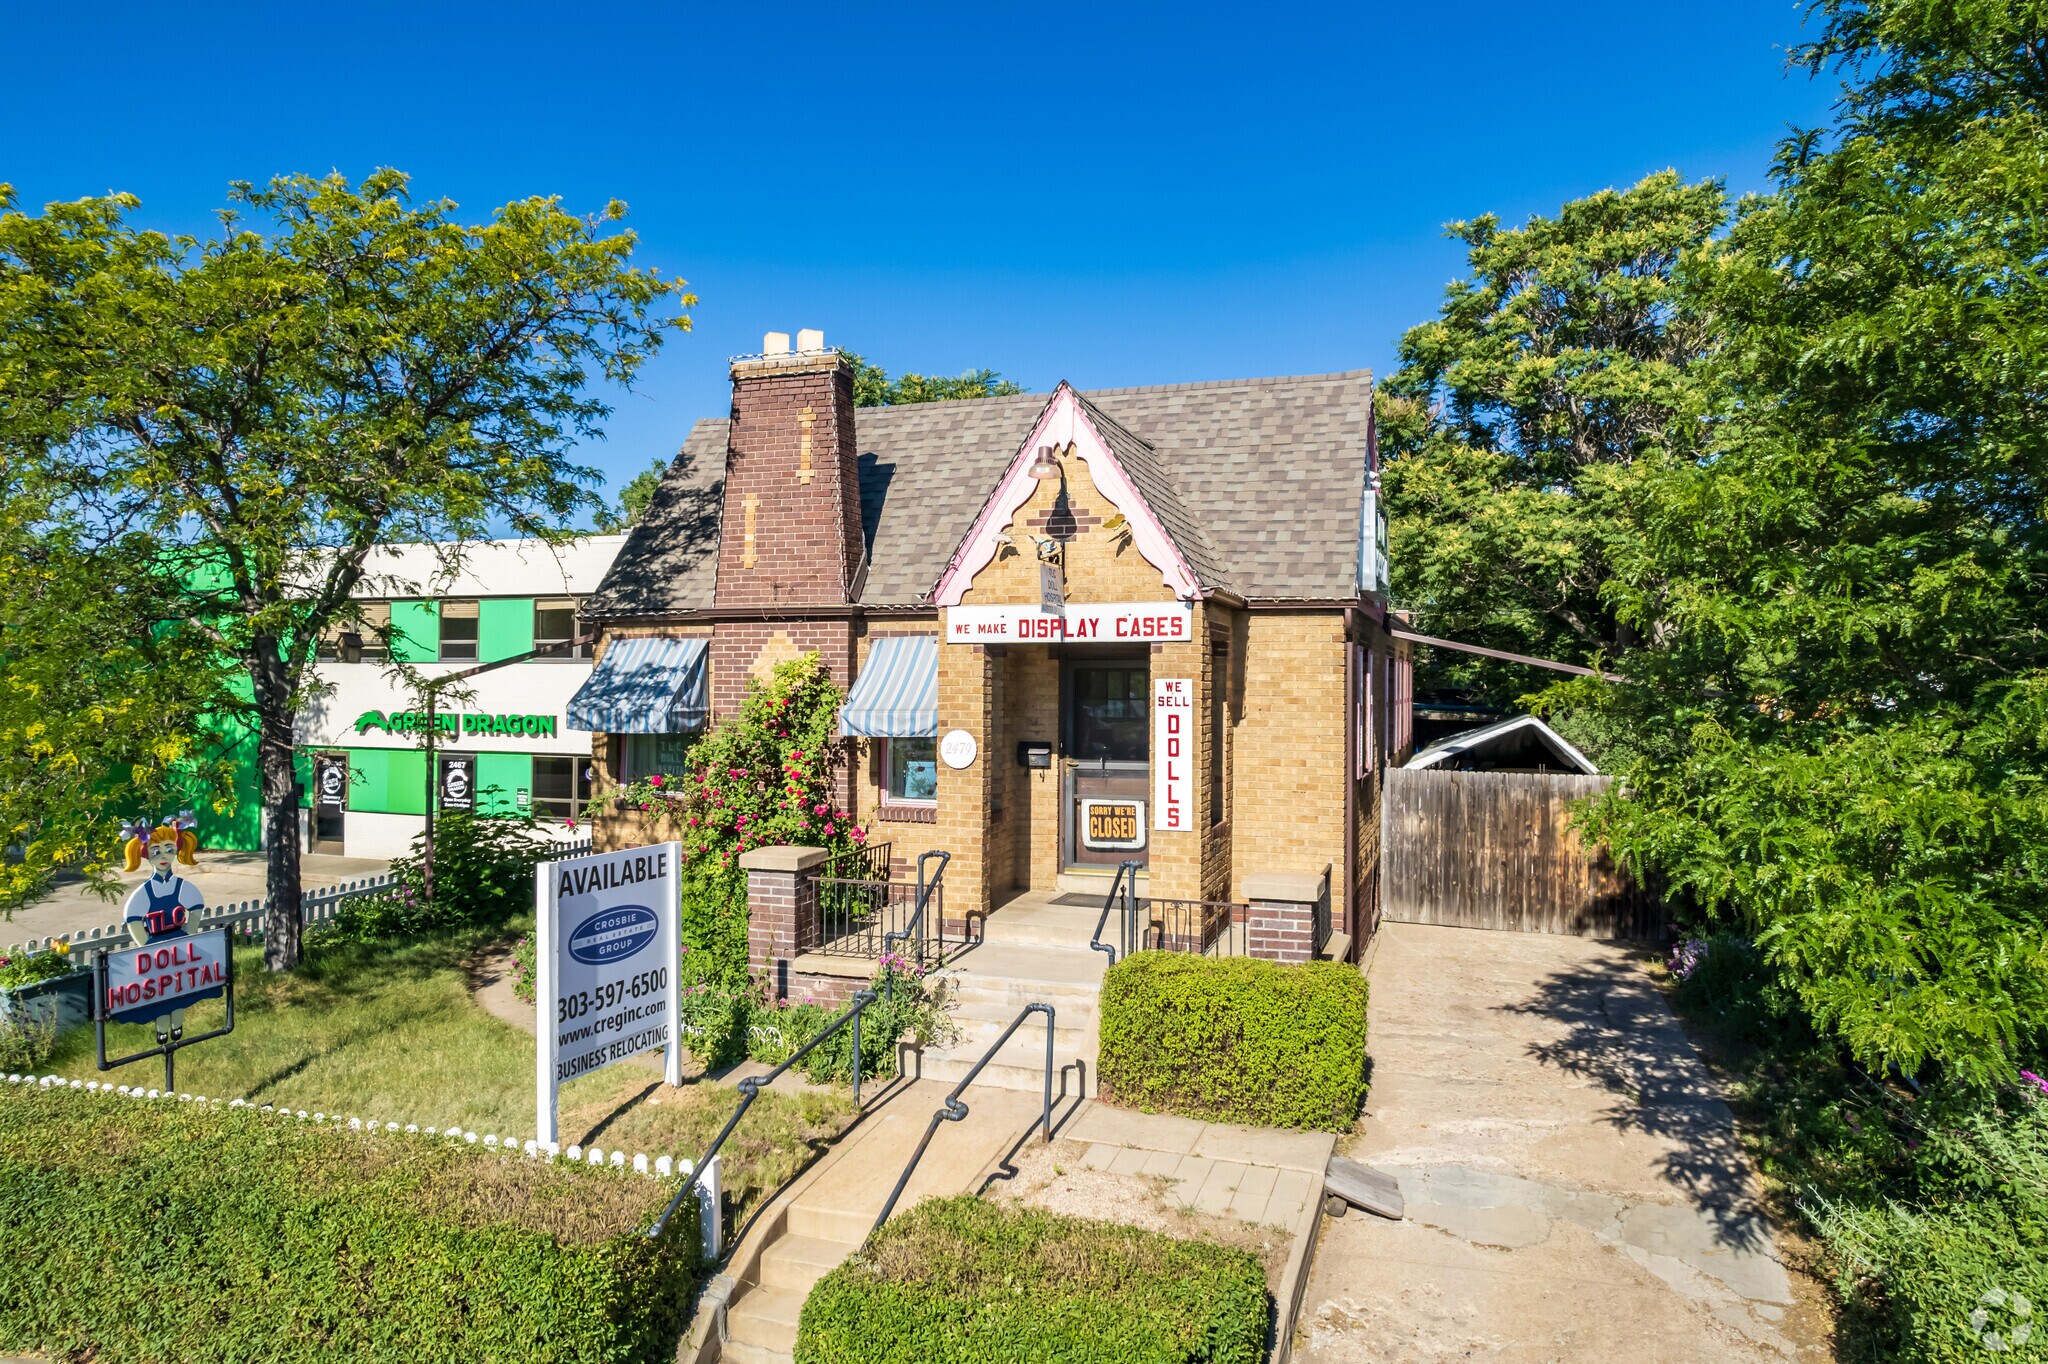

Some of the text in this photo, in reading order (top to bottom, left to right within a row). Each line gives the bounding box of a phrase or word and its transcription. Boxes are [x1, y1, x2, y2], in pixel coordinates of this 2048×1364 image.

[1047, 579, 1058, 591] DOLL
[955, 616, 1183, 638] WE MAKE DISPLAY CASES
[1165, 681, 1182, 692] WE
[1158, 696, 1189, 707] SELL
[389, 712, 553, 735] GREEN DRAGON
[945, 742, 972, 755] 2479
[448, 761, 467, 769] 2467
[1168, 714, 1180, 828] DOLLS
[1090, 806, 1136, 816] SORRY WE'RE
[1090, 816, 1136, 839] CLOSED
[558, 853, 667, 899] AVAILABLE
[146, 905, 187, 934] TLC
[594, 913, 637, 931] CROSBIE
[586, 925, 644, 944] REAL ESTATE
[598, 939, 633, 955] GROUP
[136, 942, 202, 975] DOLL
[108, 961, 228, 1009] HOSPITAL
[558, 966, 668, 1024] 303-597-6500
[558, 1000, 666, 1047] www.creginc.com
[557, 1024, 668, 1081] BUSINESS RELOCATING
